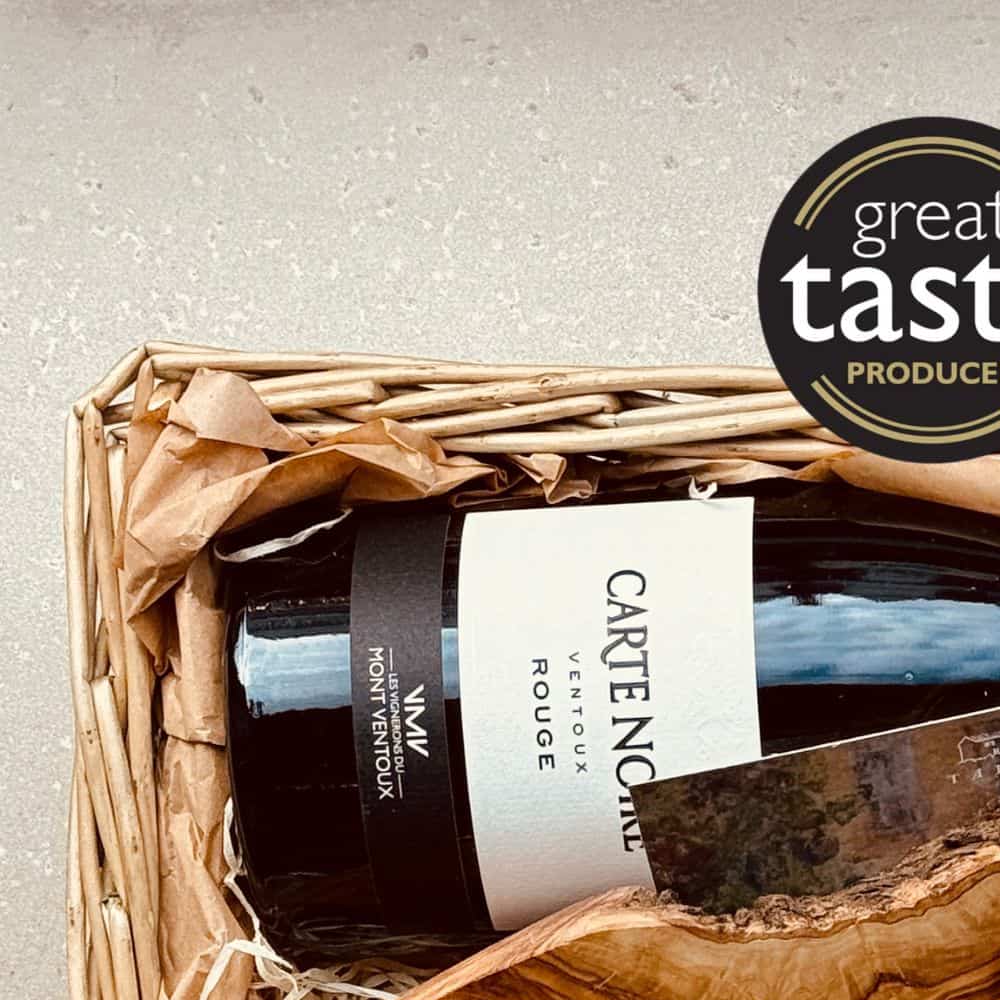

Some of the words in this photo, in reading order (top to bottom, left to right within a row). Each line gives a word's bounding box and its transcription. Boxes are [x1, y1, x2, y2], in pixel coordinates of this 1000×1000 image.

[600, 569, 651, 704] CARTE
[368, 647, 386, 705] MONT
[388, 673, 399, 690] LES
[531, 658, 556, 771] ROUGE
[568, 651, 588, 774] VENTOUX
[371, 708, 395, 800] VENTOUX
[389, 691, 403, 755] VIGNERONS
[394, 755, 405, 773] DU
